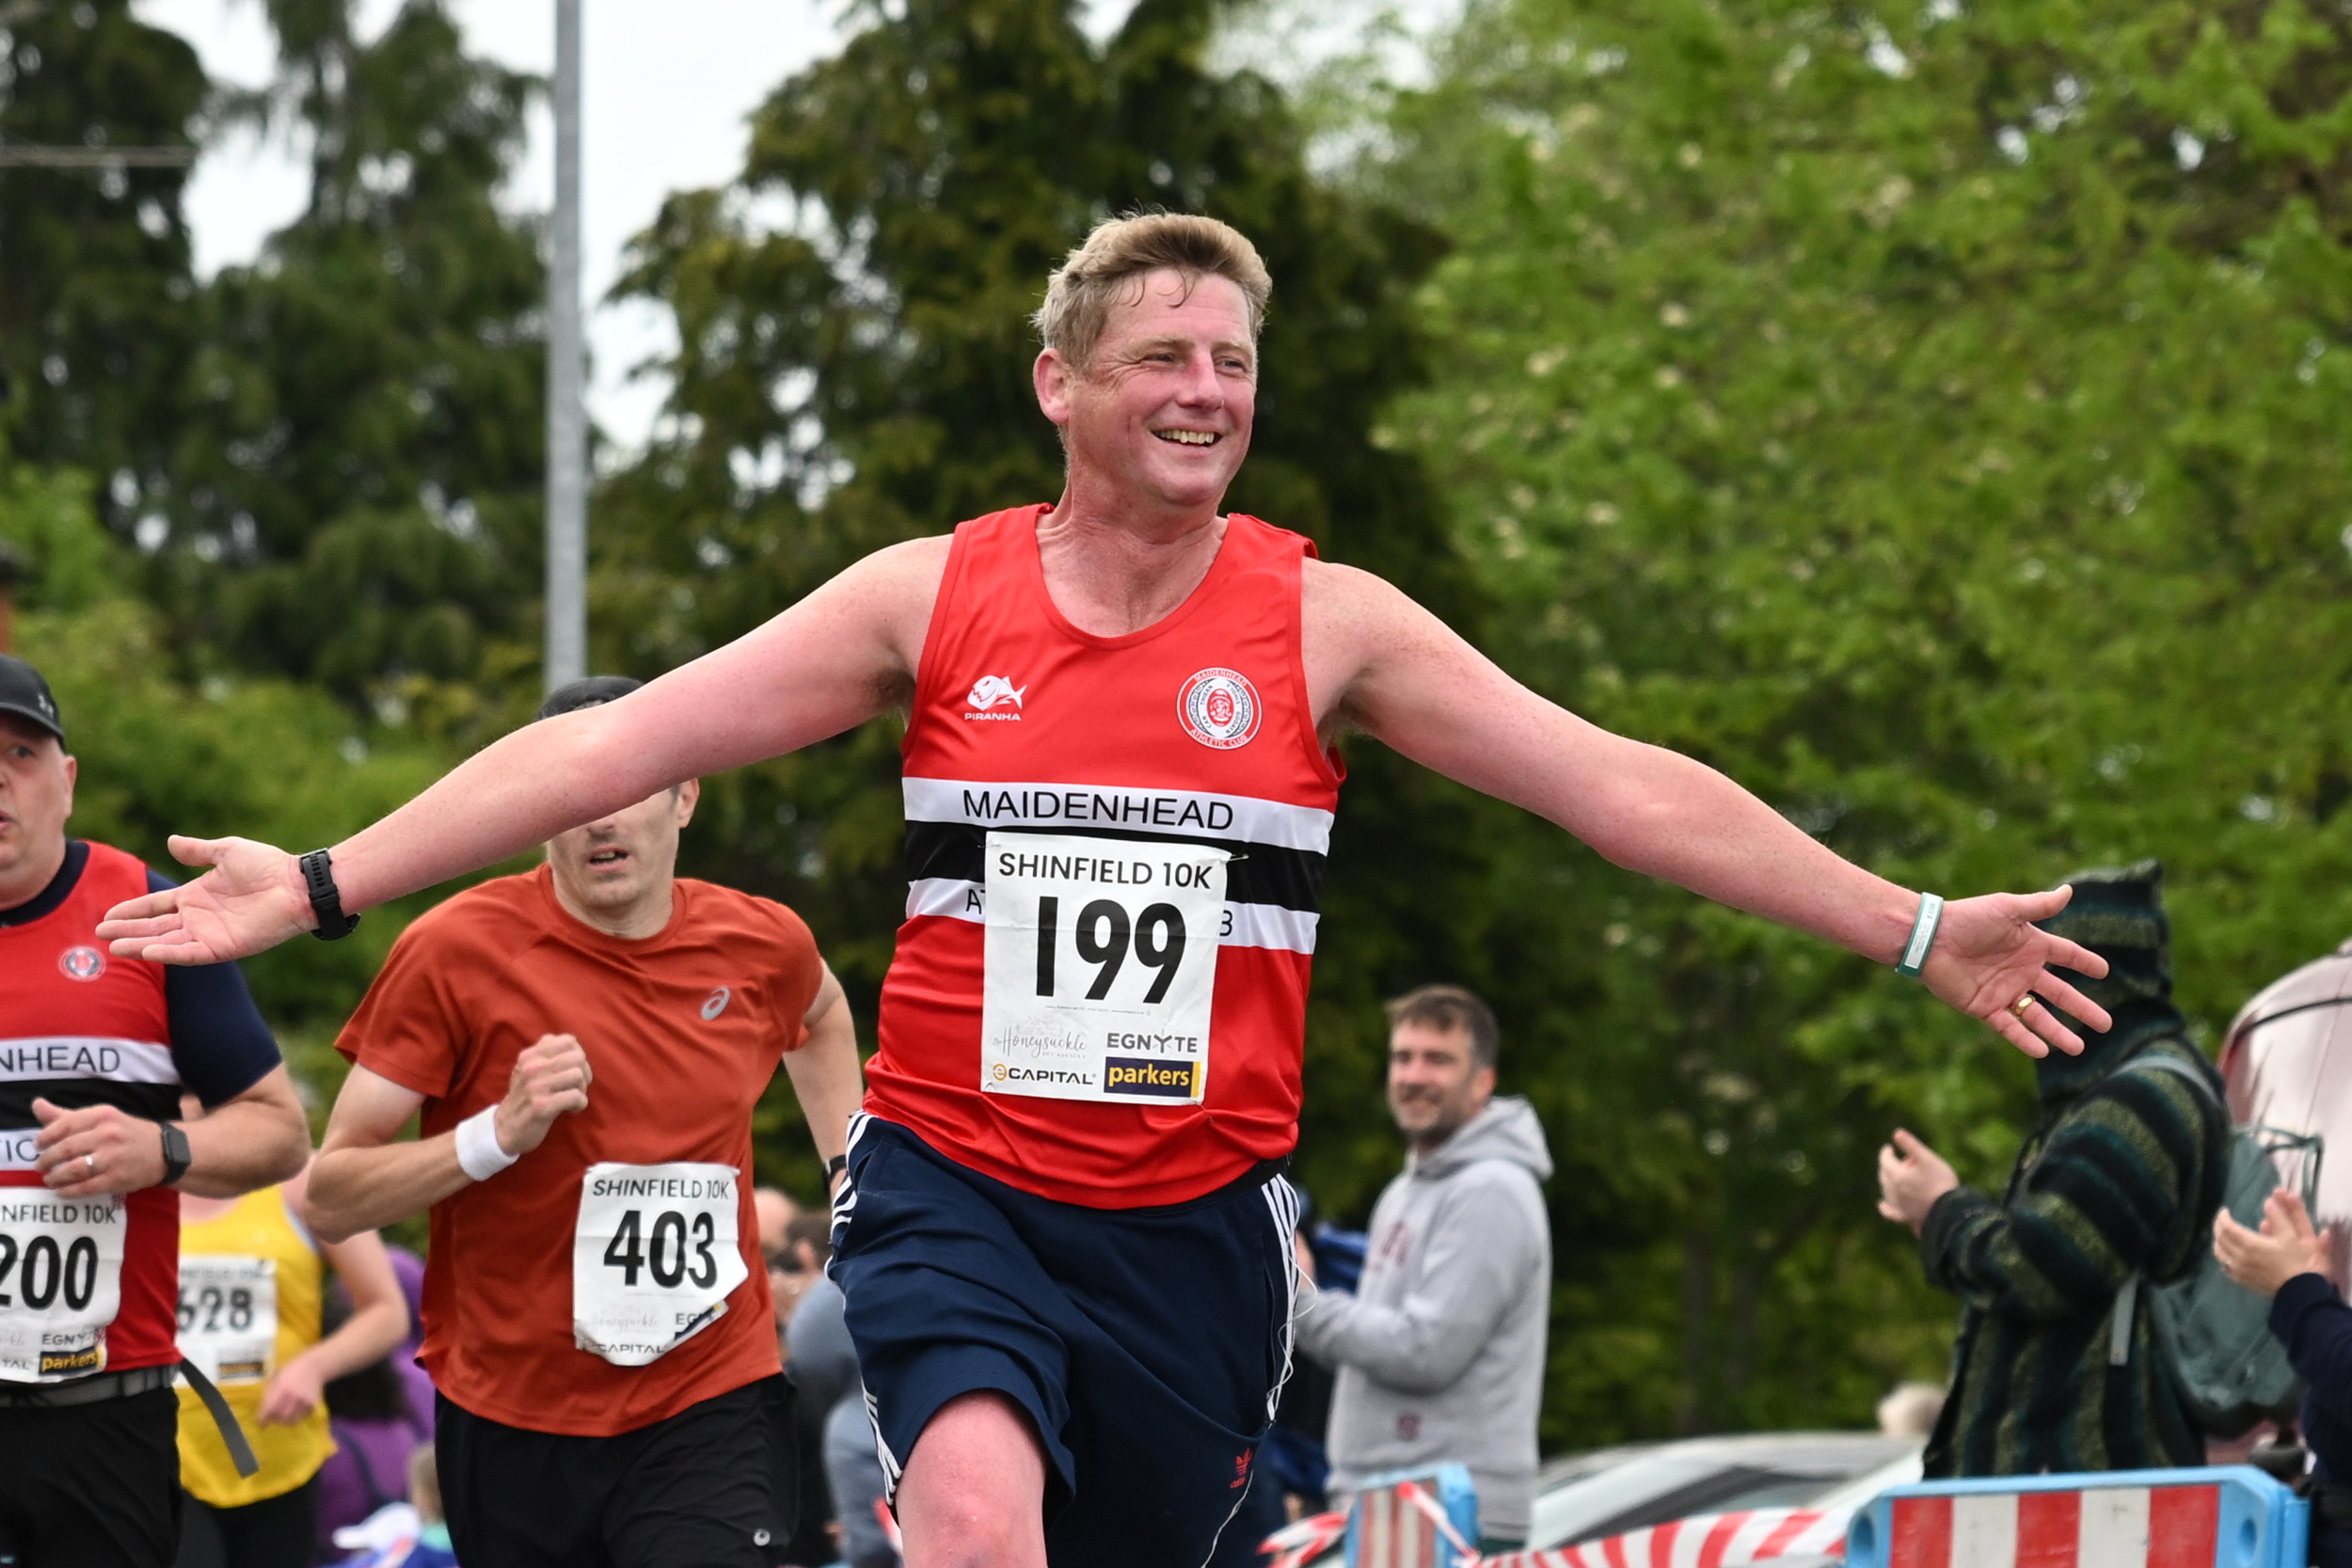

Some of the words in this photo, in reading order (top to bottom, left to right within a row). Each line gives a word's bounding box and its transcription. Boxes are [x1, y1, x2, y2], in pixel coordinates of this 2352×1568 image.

[1194, 670, 1247, 688] MAIDENHEAD
[1191, 729, 1226, 747] ATHLETIC
[1229, 735, 1248, 748] CLUB
[962, 789, 1233, 830] MAIDENHEAD
[998, 852, 1152, 885] SHINFIELD
[1163, 863, 1214, 889] 10K
[1036, 895, 1187, 1005] 199
[996, 1027, 1087, 1058] Honeysuckle
[1106, 1033, 1198, 1053] EGNYTE
[0, 1046, 120, 1072] NHEAD
[1108, 1063, 1189, 1086] parkers
[592, 1179, 703, 1198] SHINFIELD
[707, 1180, 730, 1199] 10K
[0, 1205, 78, 1224] NFIELD
[85, 1205, 117, 1224] 10K
[603, 1210, 718, 1289] 403
[0, 1234, 98, 1311] 200
[41, 1352, 96, 1372] parkers
